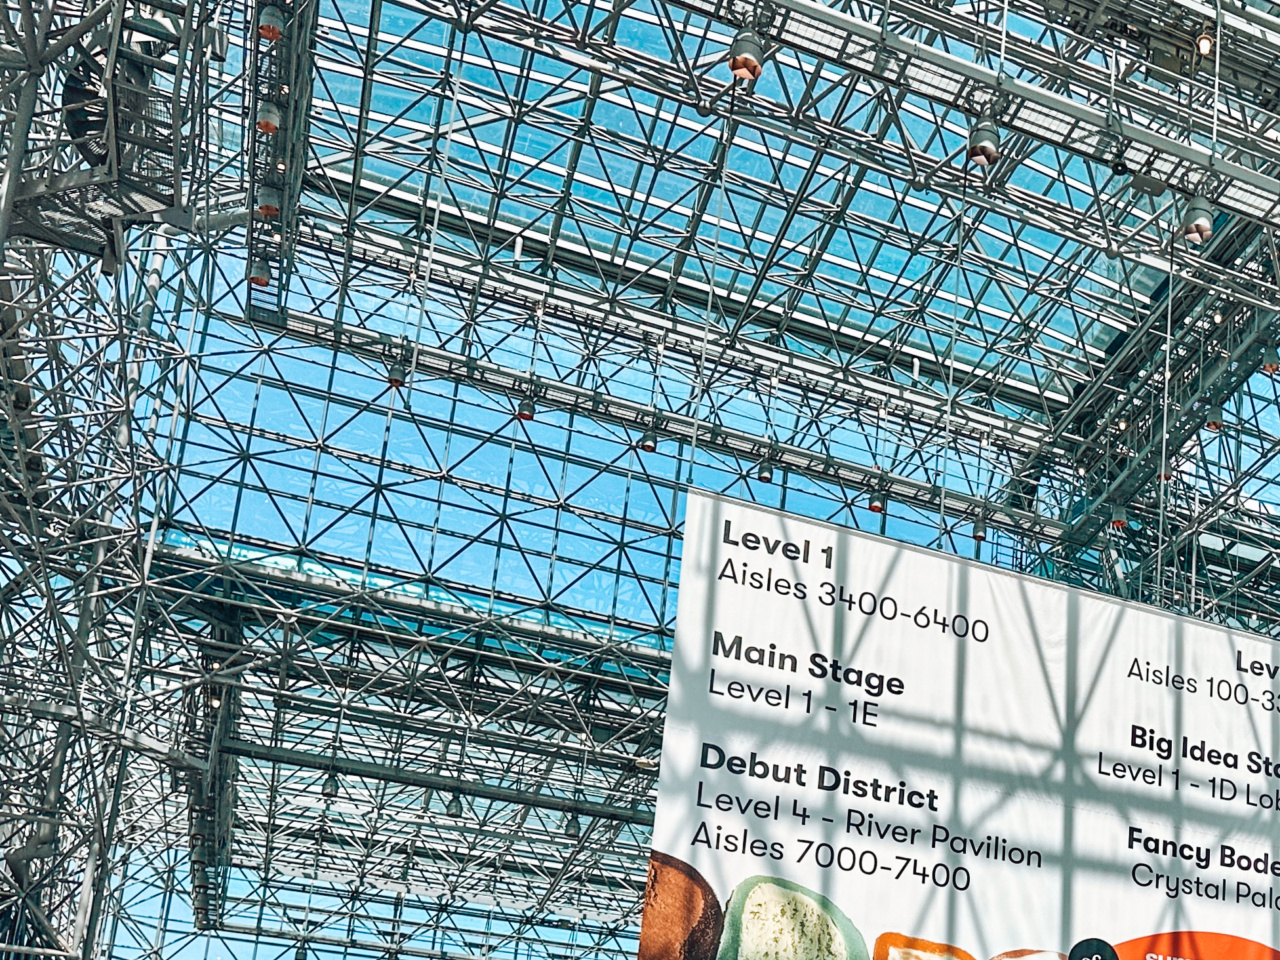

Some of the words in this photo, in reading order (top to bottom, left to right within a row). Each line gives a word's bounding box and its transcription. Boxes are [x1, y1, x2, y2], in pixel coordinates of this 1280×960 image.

[723, 520, 810, 563] Level
[821, 546, 833, 569] 1
[718, 558, 808, 600] Aisles
[818, 582, 989, 643] 3400-6400
[712, 630, 797, 672] Main
[808, 653, 905, 697] Stage
[1127, 657, 1198, 693] Aisles
[709, 668, 790, 709] Level
[802, 690, 812, 714] 1
[849, 699, 879, 727] 1E
[1131, 724, 1172, 760] Big
[1182, 736, 1238, 769] Idea
[700, 743, 806, 786] Debut
[818, 765, 938, 812] District
[1098, 752, 1162, 787] Level
[1172, 768, 1180, 791] 1
[1209, 777, 1237, 801] 1D
[696, 781, 779, 820] Level
[792, 799, 811, 826] 4
[846, 808, 921, 845] River
[931, 824, 1043, 868] Pavilion
[1128, 826, 1211, 869] Fancy
[690, 821, 784, 860] Aisles
[796, 839, 971, 891] 7000-7400
[1131, 862, 1226, 901] Crystal
